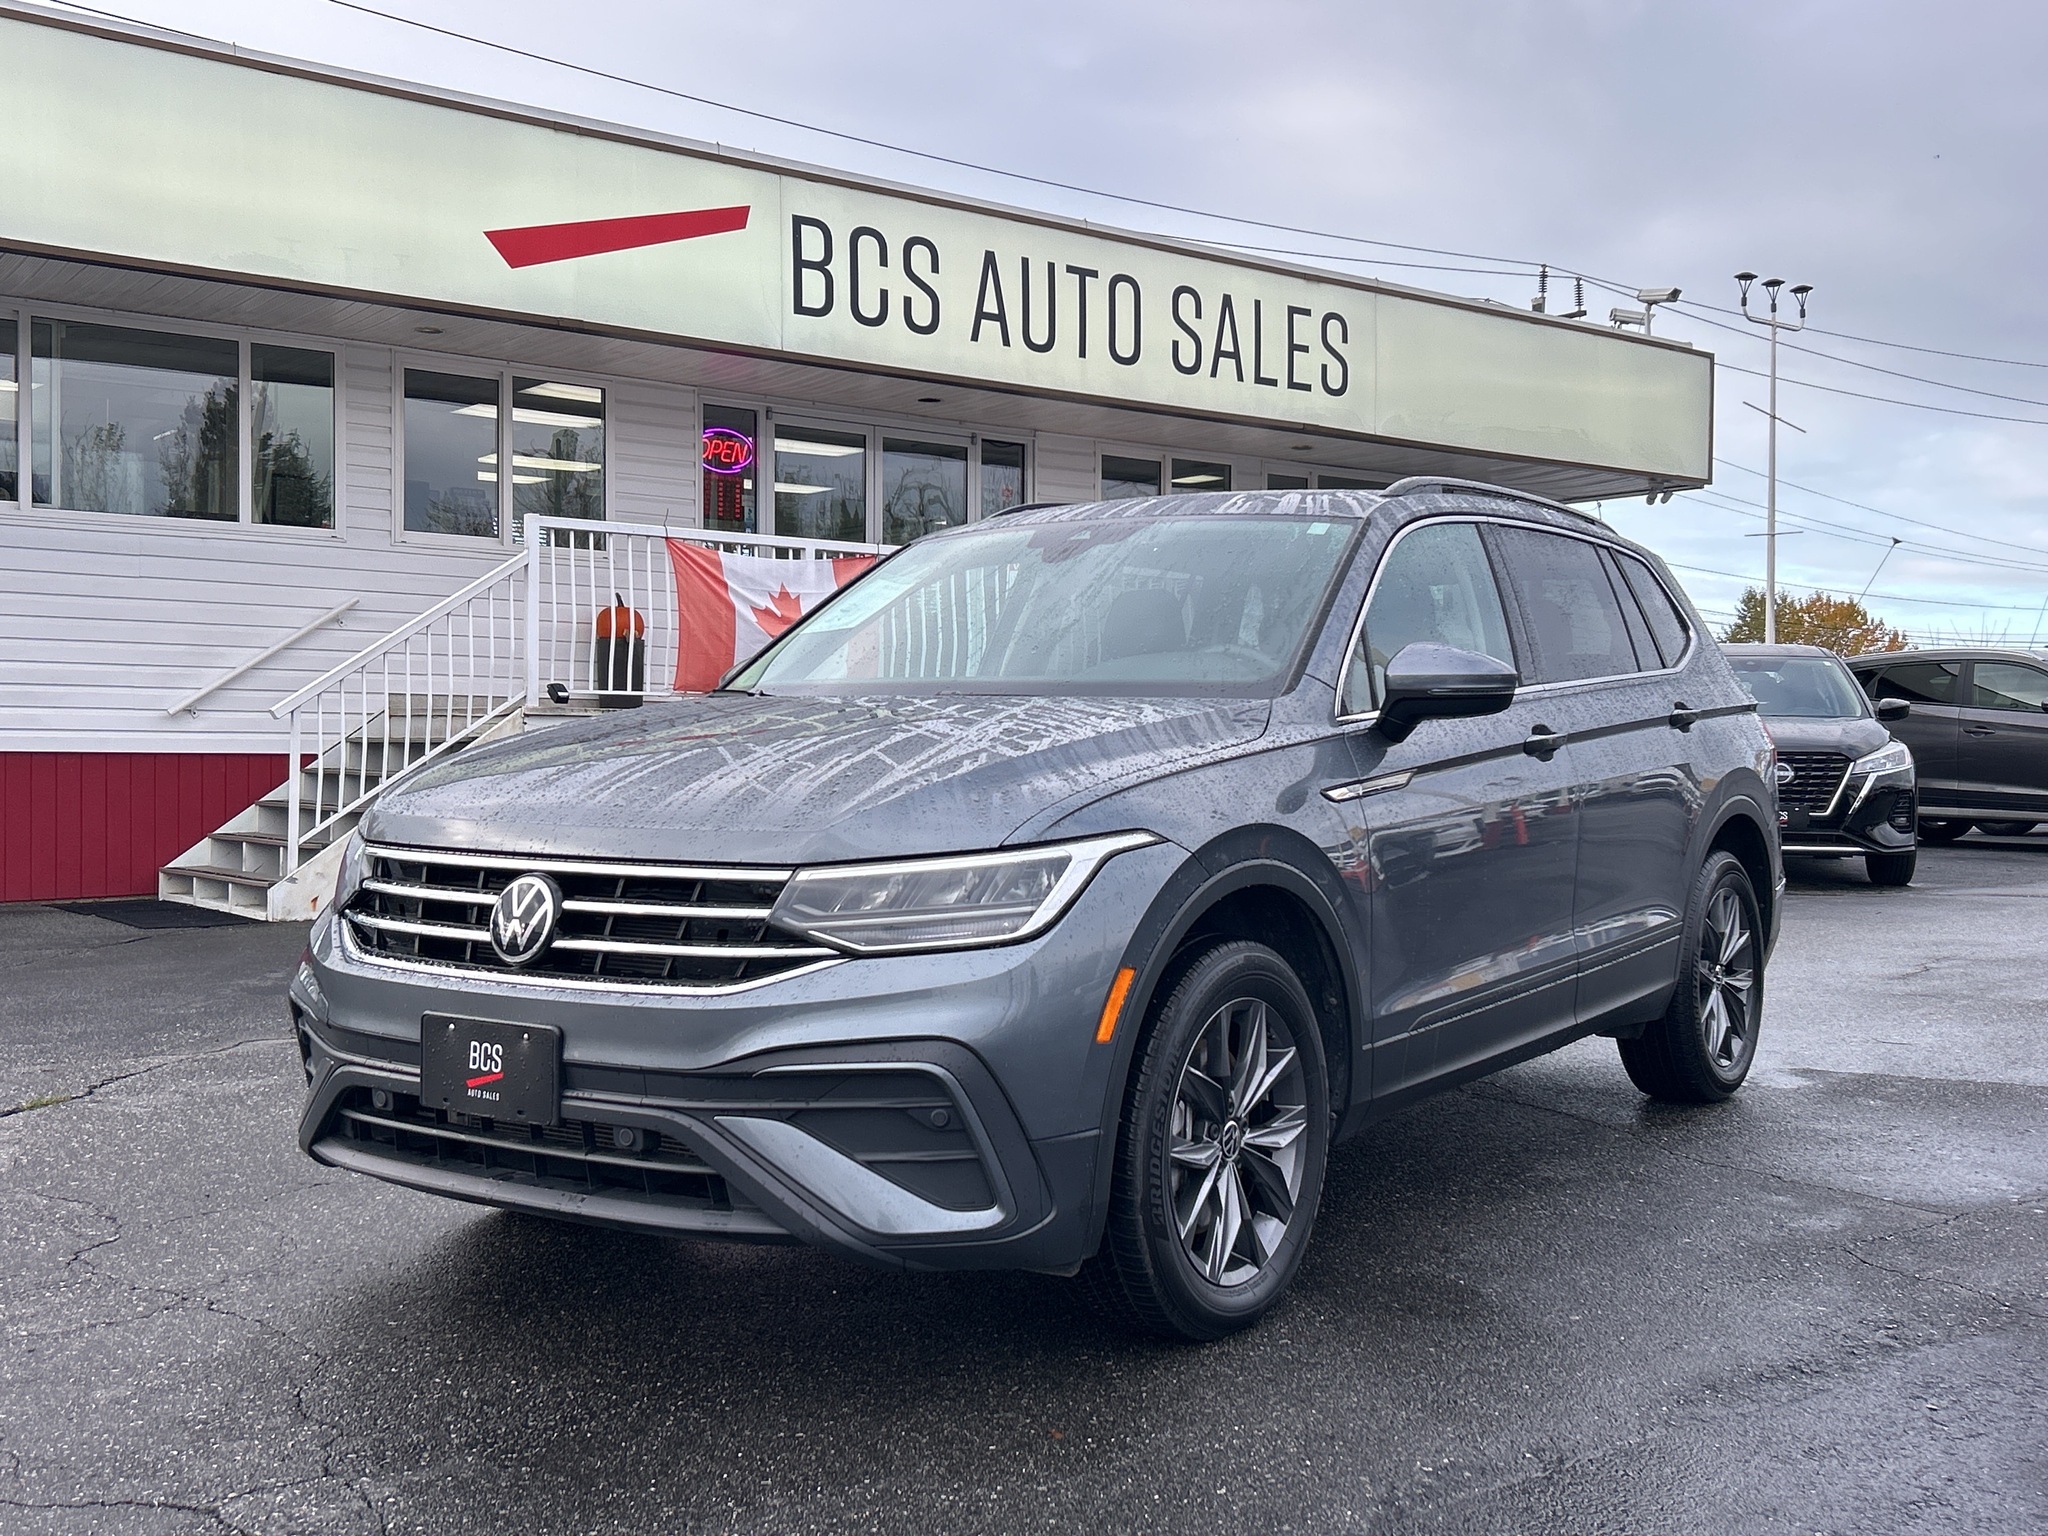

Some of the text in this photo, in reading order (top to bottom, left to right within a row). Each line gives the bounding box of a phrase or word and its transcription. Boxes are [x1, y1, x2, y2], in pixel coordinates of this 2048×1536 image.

[792, 214, 1349, 396] BCS AUTO SALES
[702, 438, 748, 464] OPEN
[469, 1041, 503, 1073] BCS
[467, 1088, 500, 1101] AUTO SALES
